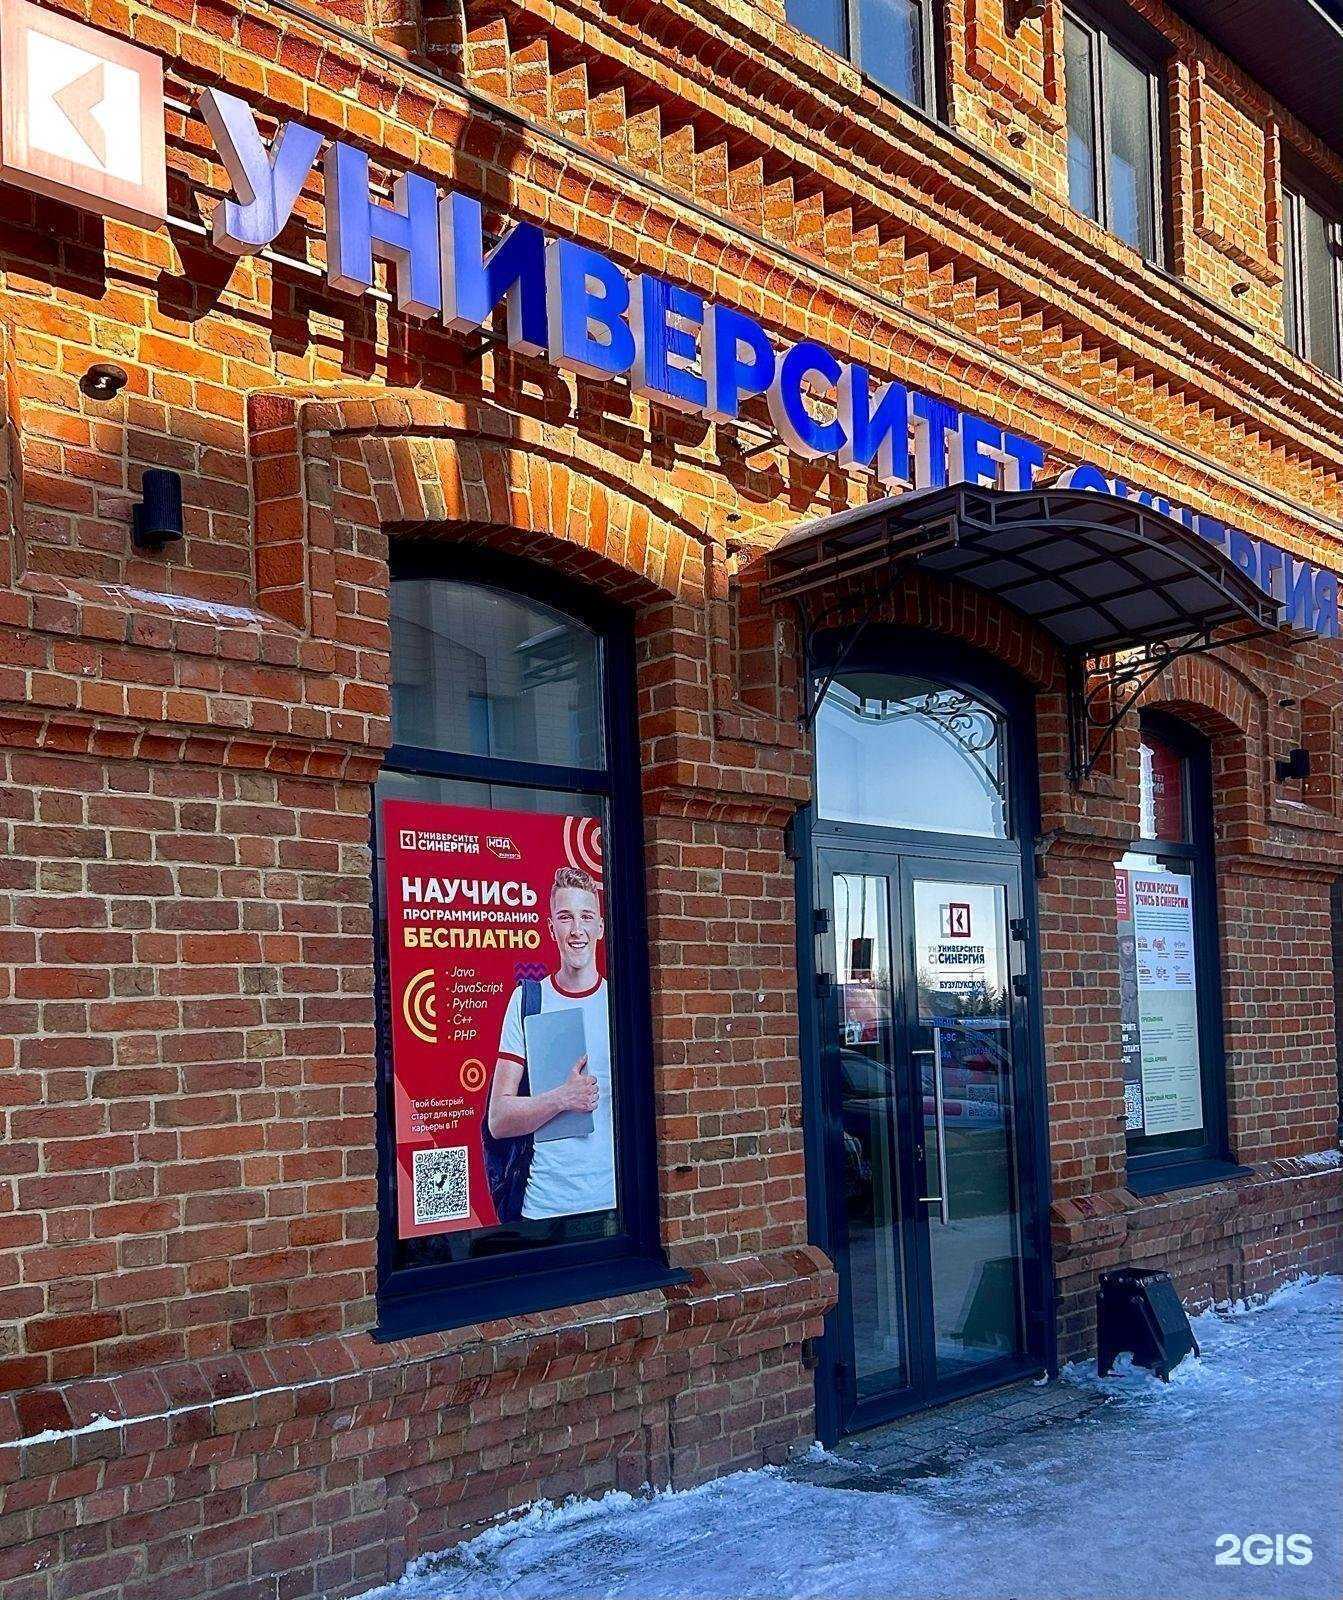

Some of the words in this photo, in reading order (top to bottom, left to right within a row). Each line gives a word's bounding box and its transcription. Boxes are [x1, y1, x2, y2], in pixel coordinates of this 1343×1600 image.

[200, 86, 1045, 491] УНИВЕРСИТЕТ
[1058, 464, 1340, 638] РГИЯ
[418, 831, 479, 843] УНИВЕРСИТЕТ
[418, 840, 480, 854] СИНЕРГИЯ
[402, 876, 538, 907] НАУЧИСЬ
[403, 909, 540, 924] ПРОГРАММИРОВАНИЮ
[404, 927, 541, 950] БЕСПЛАТНО
[937, 945, 985, 953] УНИВЕРСИТЕТ
[938, 953, 985, 964] СИНЕРГИЯ
[451, 966, 475, 978] Java
[452, 982, 504, 995] JavaScript
[453, 998, 488, 1012] Python
[453, 1014, 473, 1025] C++
[454, 1029, 477, 1041] PHP
[410, 1099, 430, 1109] Твой
[430, 1096, 465, 1108] быстрый
[411, 1112, 433, 1121] старт
[433, 1110, 448, 1120] для
[448, 1107, 475, 1119] крутой
[411, 1122, 445, 1133] карьеры
[451, 1119, 459, 1129] IT
